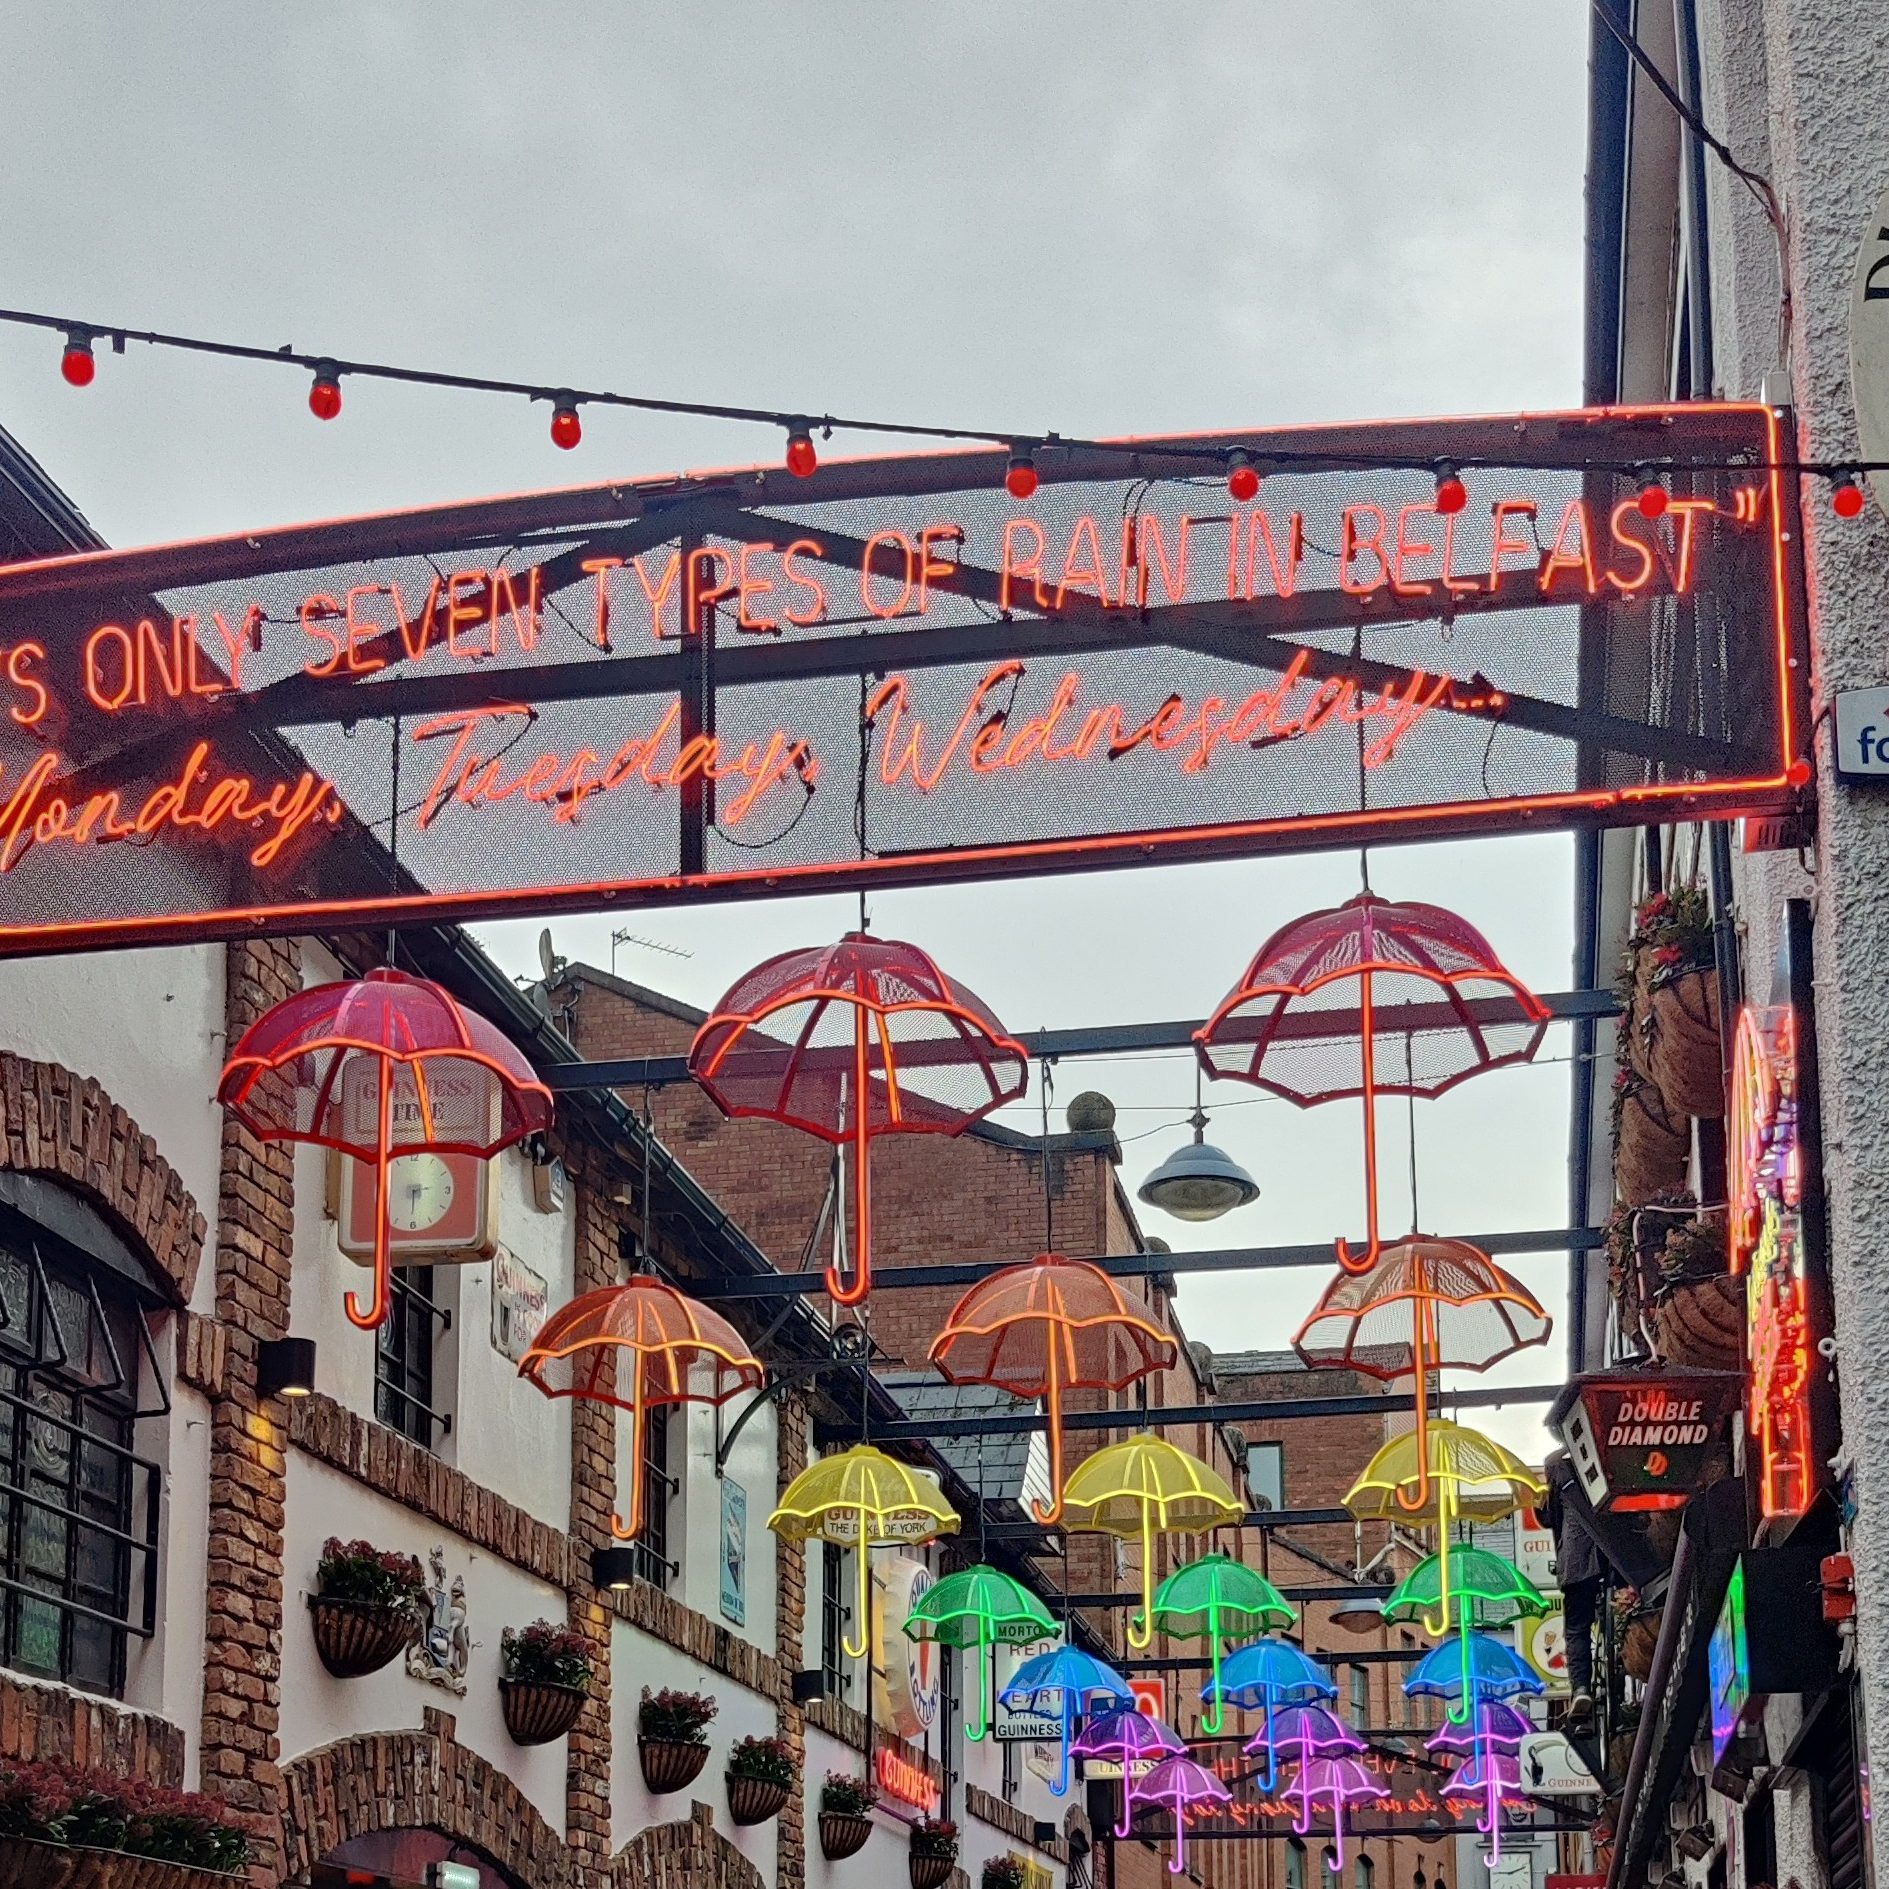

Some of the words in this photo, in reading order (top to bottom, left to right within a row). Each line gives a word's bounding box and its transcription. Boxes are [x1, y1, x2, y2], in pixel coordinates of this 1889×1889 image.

[86, 605, 262, 710] ONLY
[303, 566, 543, 676] SEVEN
[582, 540, 824, 647] TYPES
[863, 525, 963, 618] OF
[1003, 514, 1188, 613] RAIN
[1228, 511, 1302, 600] IN
[362, 1079, 473, 1101] GINESS
[1617, 1401, 1703, 1422] DOUBLE
[1607, 1424, 1709, 1446] DIAMOND
[829, 1522, 849, 1534] THE
[852, 1523, 880, 1535] DKE
[883, 1524, 897, 1534] OF
[900, 1522, 927, 1534] YORK
[998, 1626, 1042, 1637] MORTO
[1010, 1642, 1051, 1657] RED
[997, 1689, 1063, 1704] EART
[997, 1724, 1063, 1737] GUINNESS
[885, 1749, 936, 1810] GUINNESS
